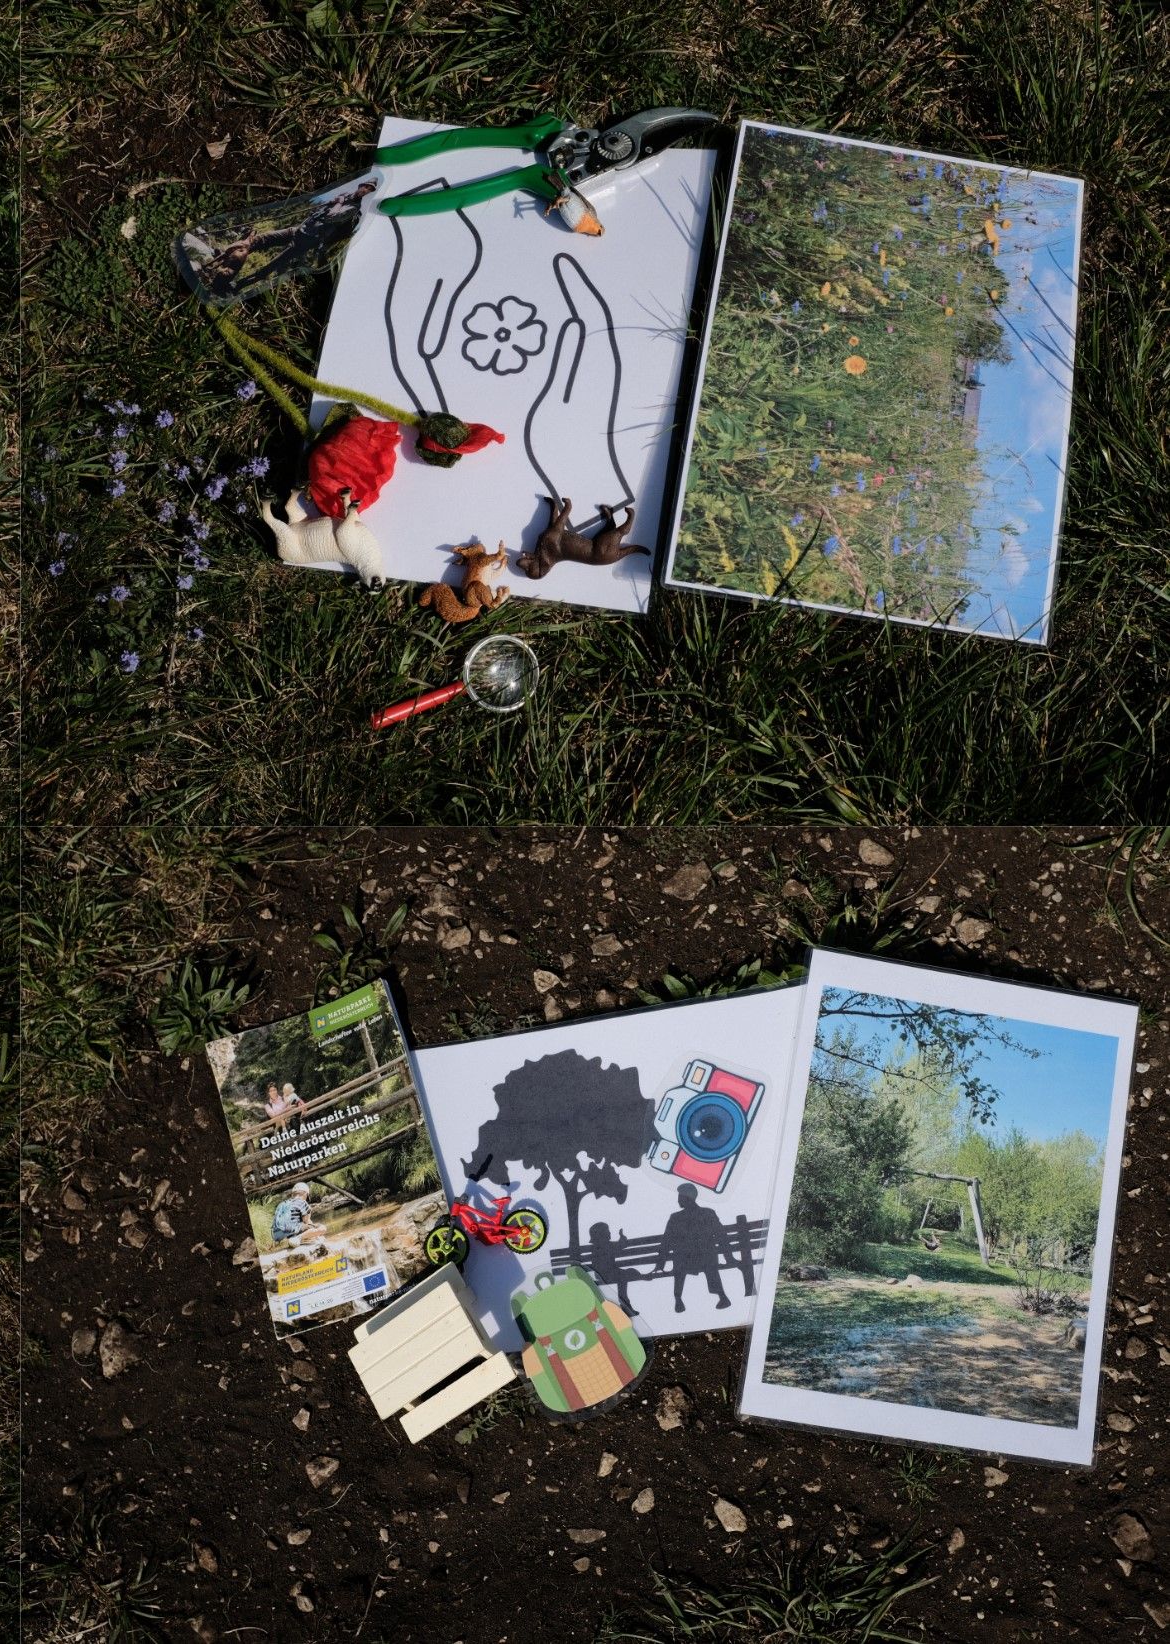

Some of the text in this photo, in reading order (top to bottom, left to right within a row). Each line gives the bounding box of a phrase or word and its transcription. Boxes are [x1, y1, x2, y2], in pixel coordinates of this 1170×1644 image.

[327, 995, 372, 1019] NATURPARKE
[318, 1028, 353, 1048] Landschaften
[367, 1014, 383, 1026] Leben
[260, 1104, 362, 1149] Deine Auszeit in
[270, 1112, 381, 1161] Niederösterreichs
[267, 1142, 348, 1178] Naturparken
[281, 1267, 314, 1282] NATURLAND
[281, 1266, 335, 1288] NIEDERÖSTERREICH
